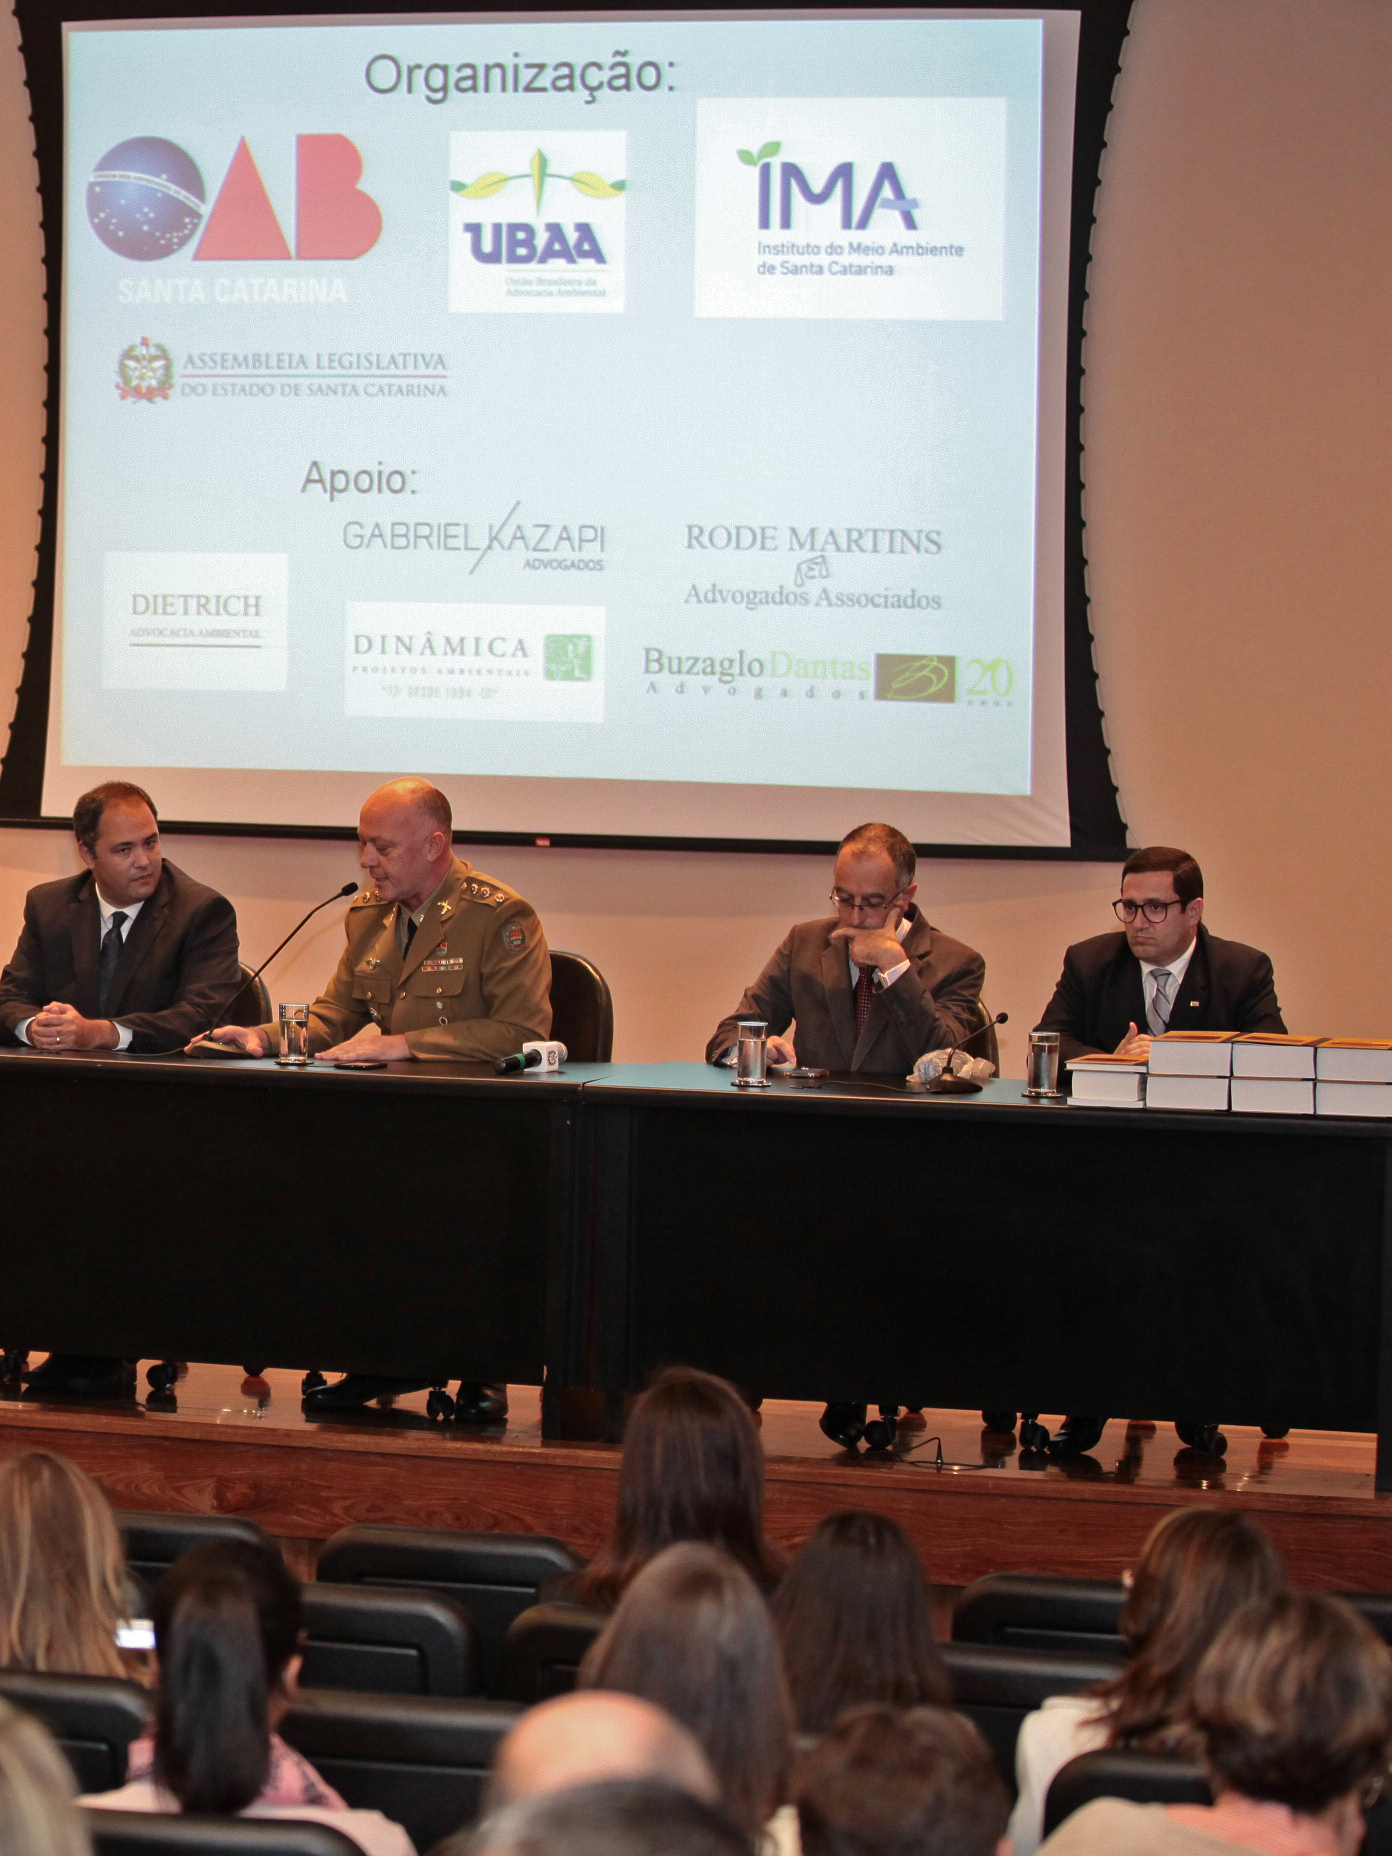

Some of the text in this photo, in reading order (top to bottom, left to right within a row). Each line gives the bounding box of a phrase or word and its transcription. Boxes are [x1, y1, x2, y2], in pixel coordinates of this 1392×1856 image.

[364, 49, 675, 105] Organização:
[87, 133, 384, 262] OAB
[758, 161, 920, 230] IMA
[462, 222, 608, 264] UBAA
[757, 241, 965, 257] Instituto do Meio Ambiente
[756, 260, 895, 276] de Santa Catarina
[118, 277, 348, 304] SANTA CATARINA
[182, 352, 448, 372] ASSEMBLEIA LEGISLATIVA
[180, 383, 447, 398] DO ESTADO DE SANTA CATARINA
[300, 460, 417, 503] Apoio:
[685, 523, 943, 556] RODE MARTINS
[523, 558, 605, 572] ADVOGADOS
[130, 593, 263, 617] DIETRICH
[684, 583, 942, 611] Advogados Associados
[352, 631, 530, 659] DINÂMICA
[966, 657, 1016, 697] 20
